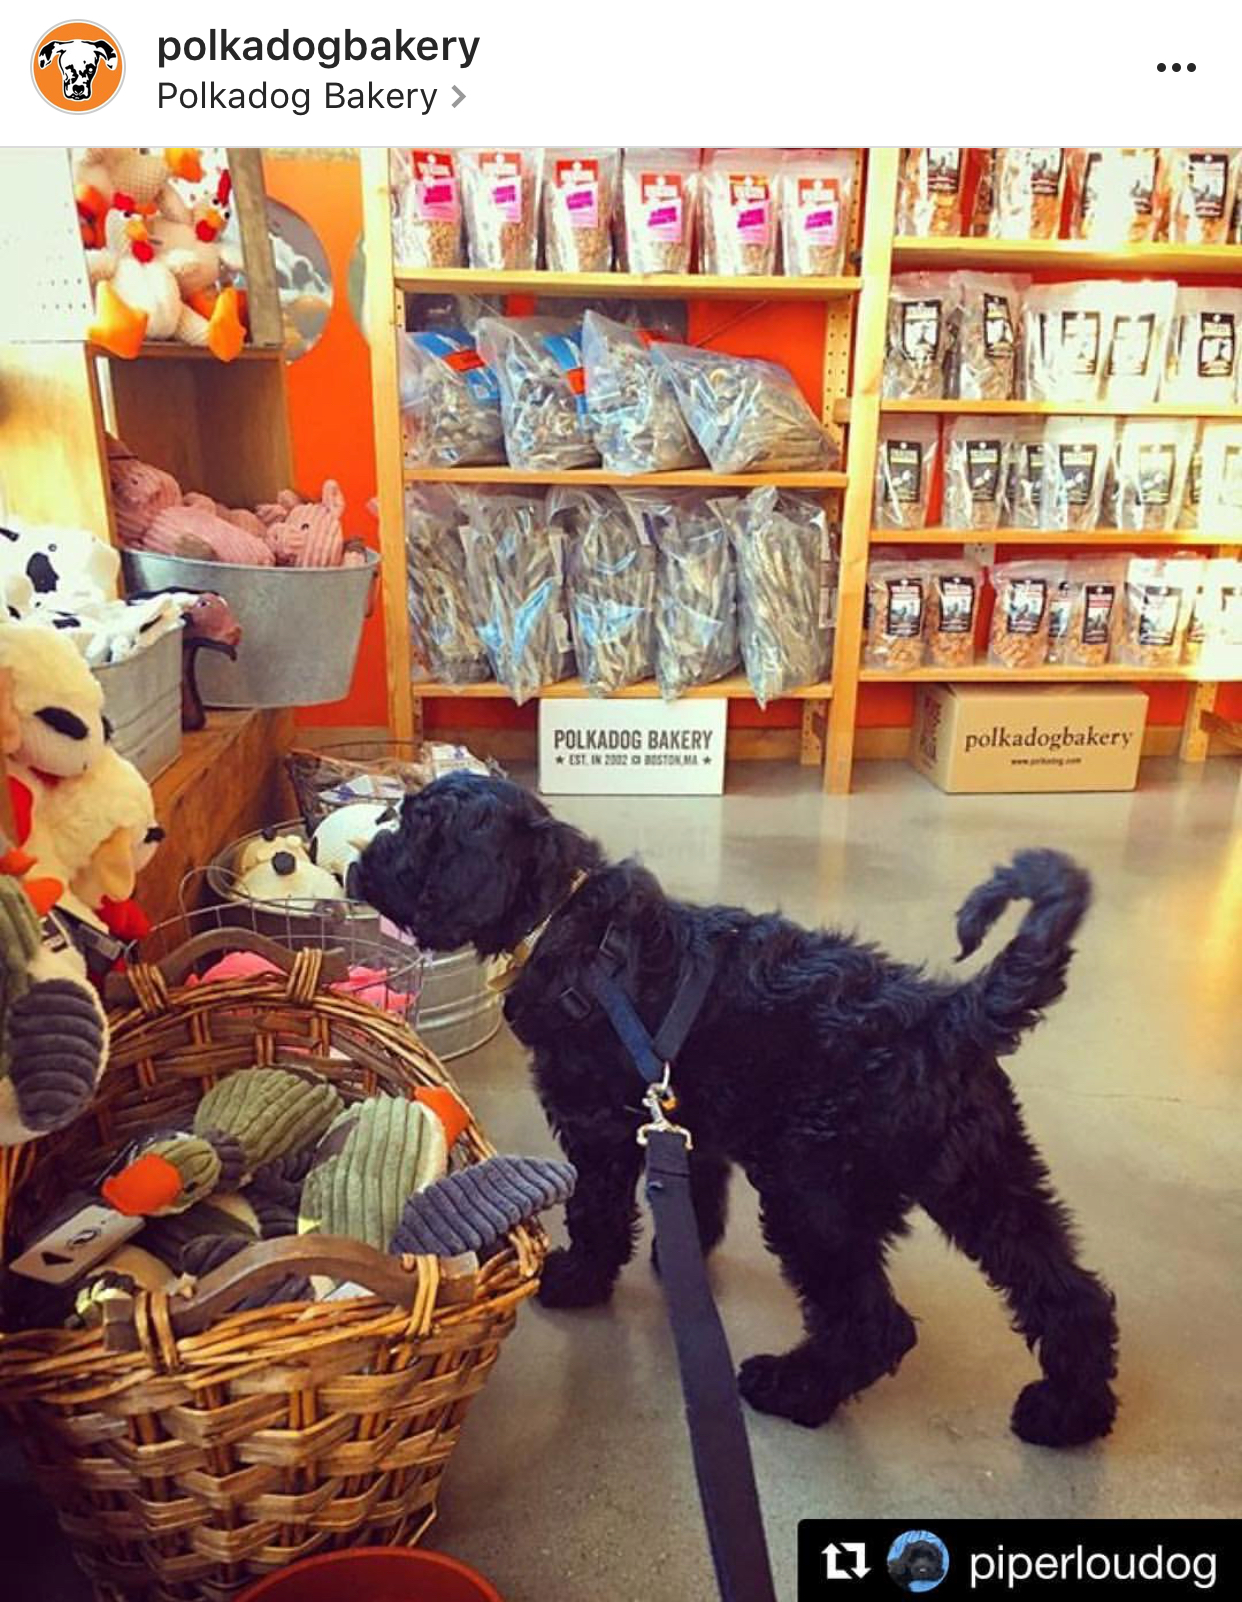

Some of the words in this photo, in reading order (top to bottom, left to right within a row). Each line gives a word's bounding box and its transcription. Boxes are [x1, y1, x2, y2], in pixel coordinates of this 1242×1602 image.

[554, 729, 642, 750] POLKADOG
[648, 729, 713, 750] BAKERY
[965, 725, 1134, 753] polkadogbakery
[591, 754, 602, 766] IN
[604, 754, 628, 766] 2002
